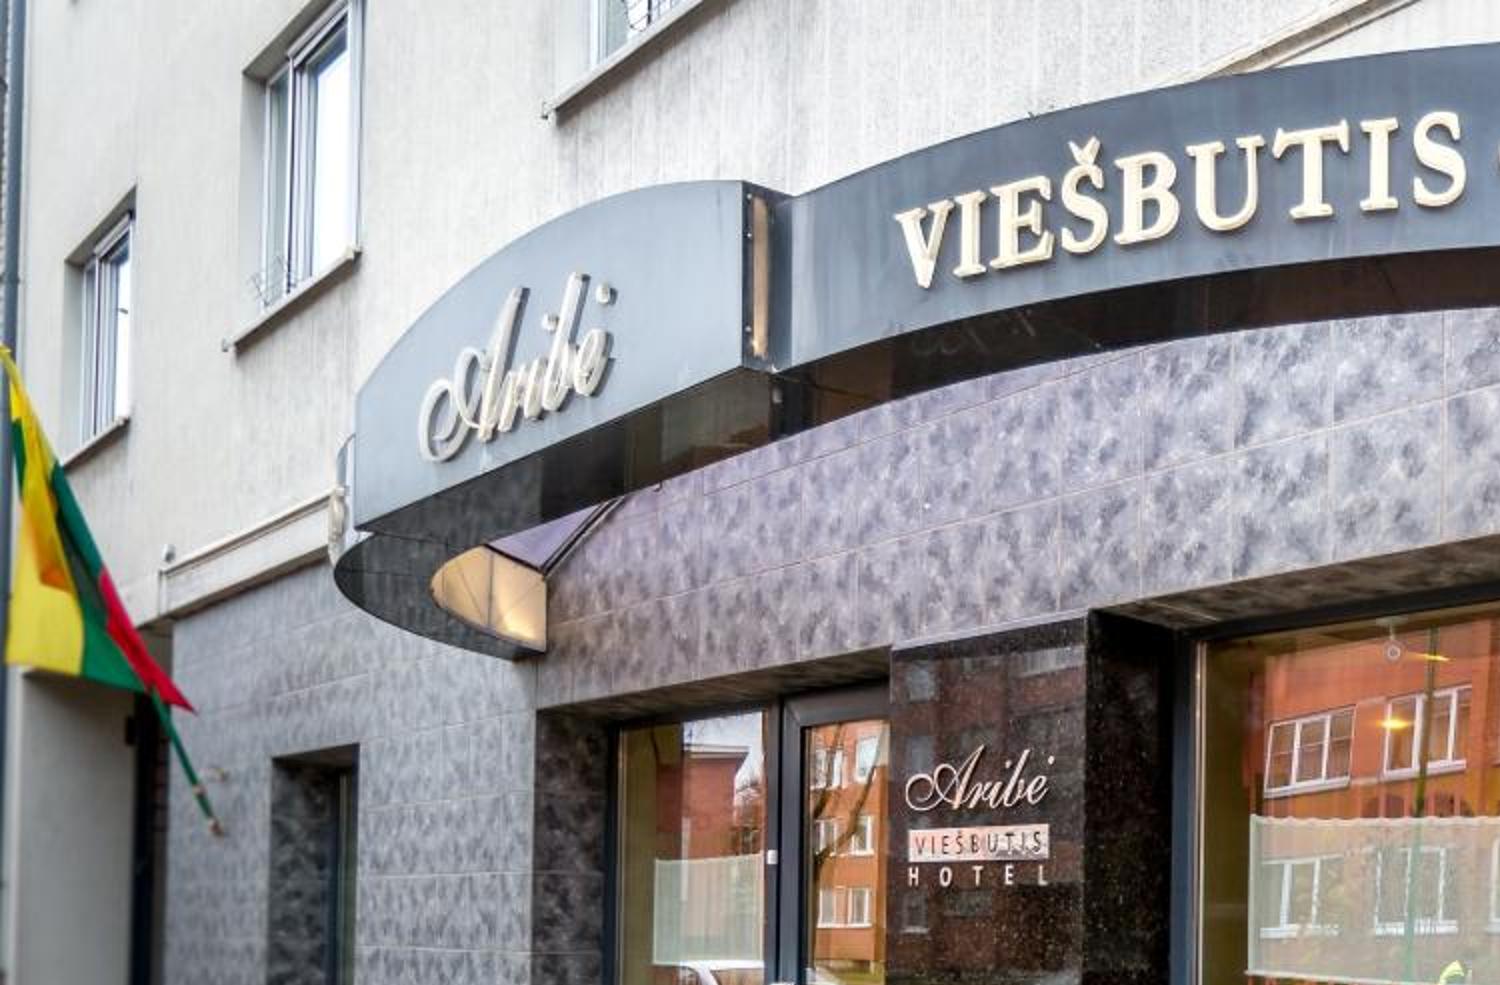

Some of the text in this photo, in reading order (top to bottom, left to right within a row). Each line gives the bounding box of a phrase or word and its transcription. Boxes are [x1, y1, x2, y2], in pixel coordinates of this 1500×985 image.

[895, 111, 1469, 289] VIEŠBUTIS
[914, 830, 1043, 855] VIEŠBUTIS
[908, 864, 1049, 888] HOTEL
